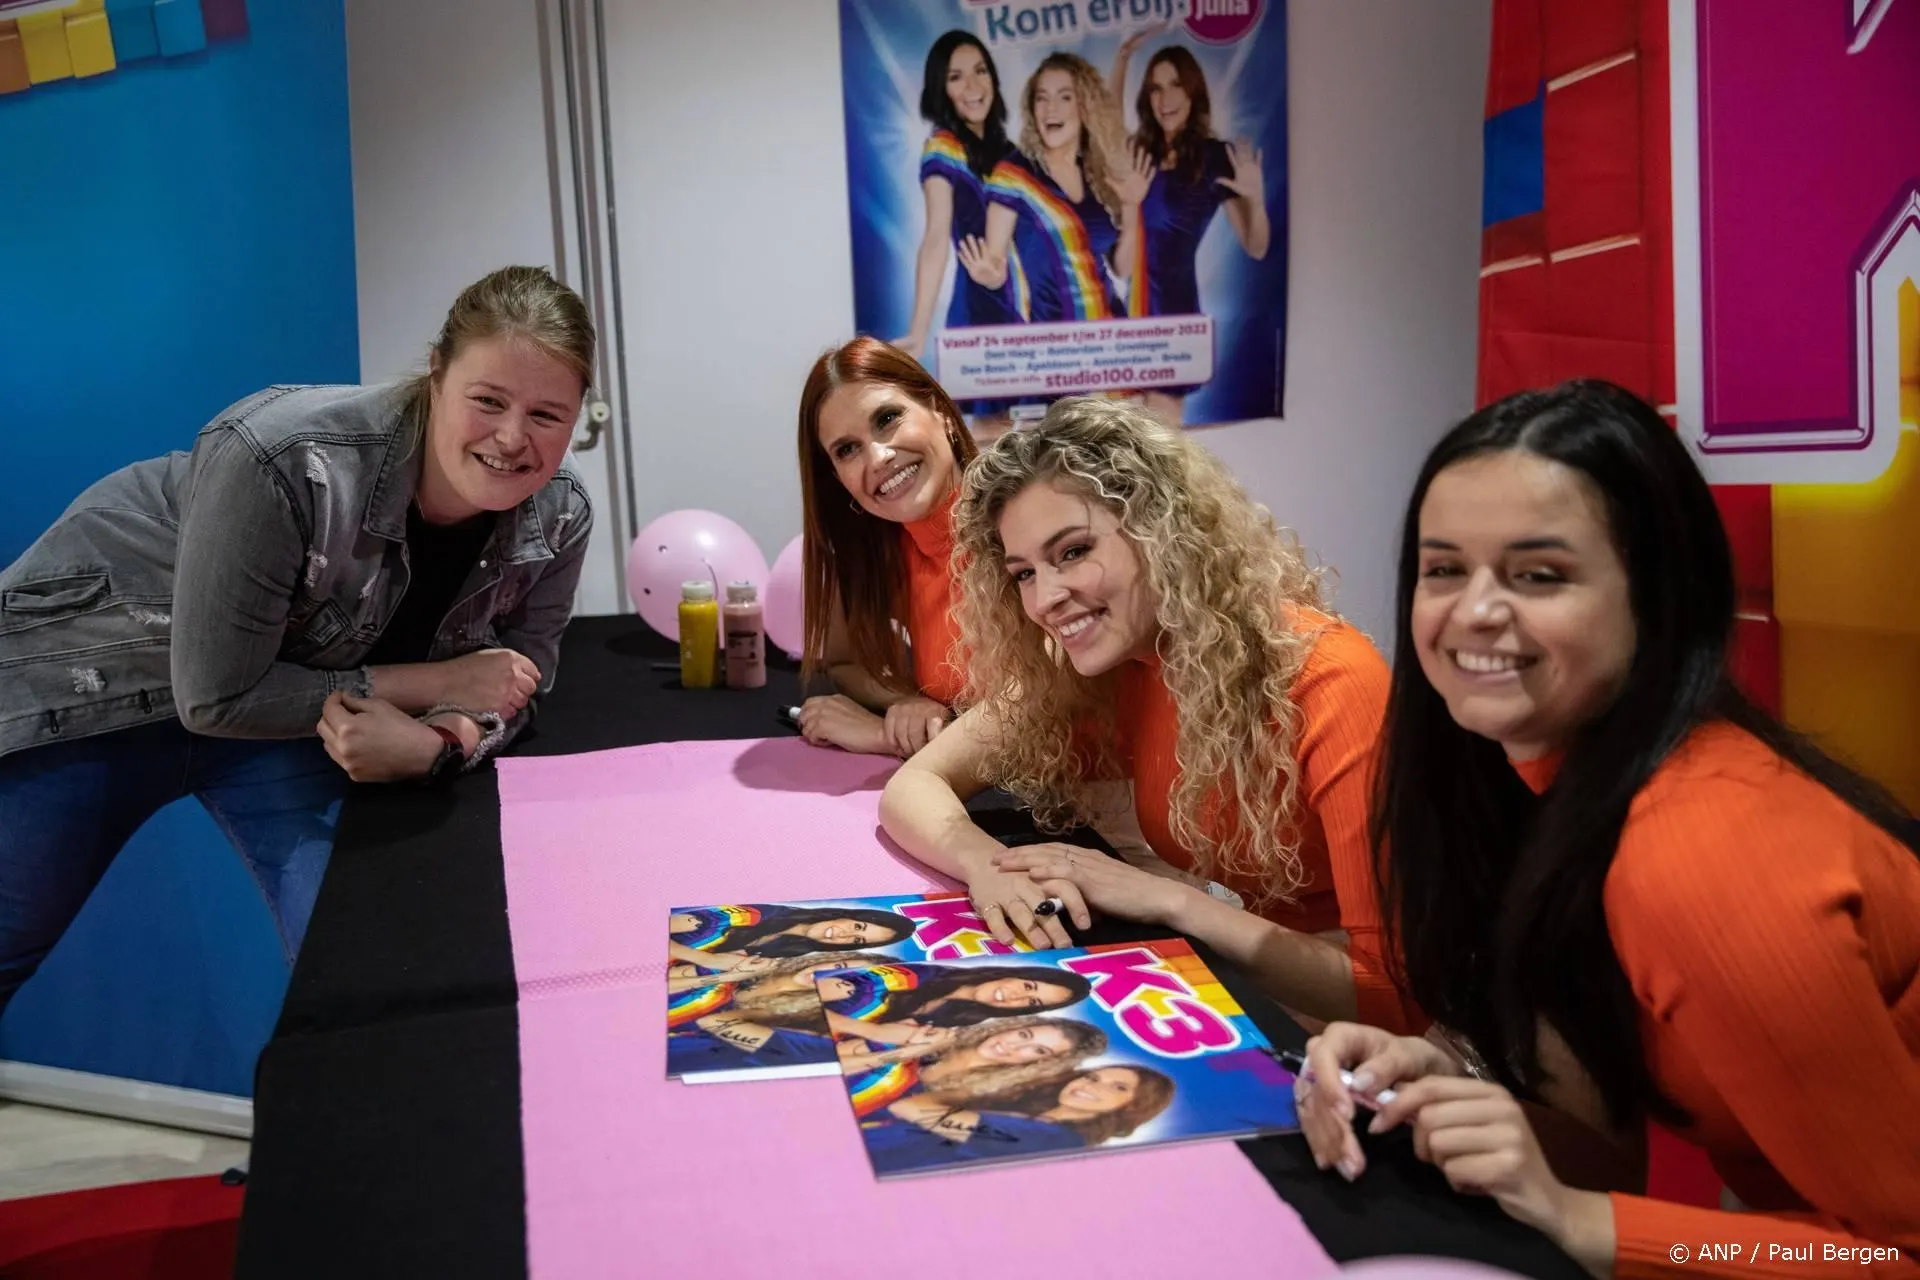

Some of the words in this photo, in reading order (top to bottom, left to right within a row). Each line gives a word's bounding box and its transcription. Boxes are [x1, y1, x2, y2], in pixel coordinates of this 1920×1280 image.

[986, 2, 1078, 41] Kom
[943, 336, 980, 351] Vanaf
[984, 336, 998, 347] 24
[1003, 332, 1069, 346] september
[1115, 326, 1174, 339] december
[1179, 323, 1207, 336] 2022
[1045, 367, 1175, 388] studio100.com
[1058, 948, 1241, 1058] K3
